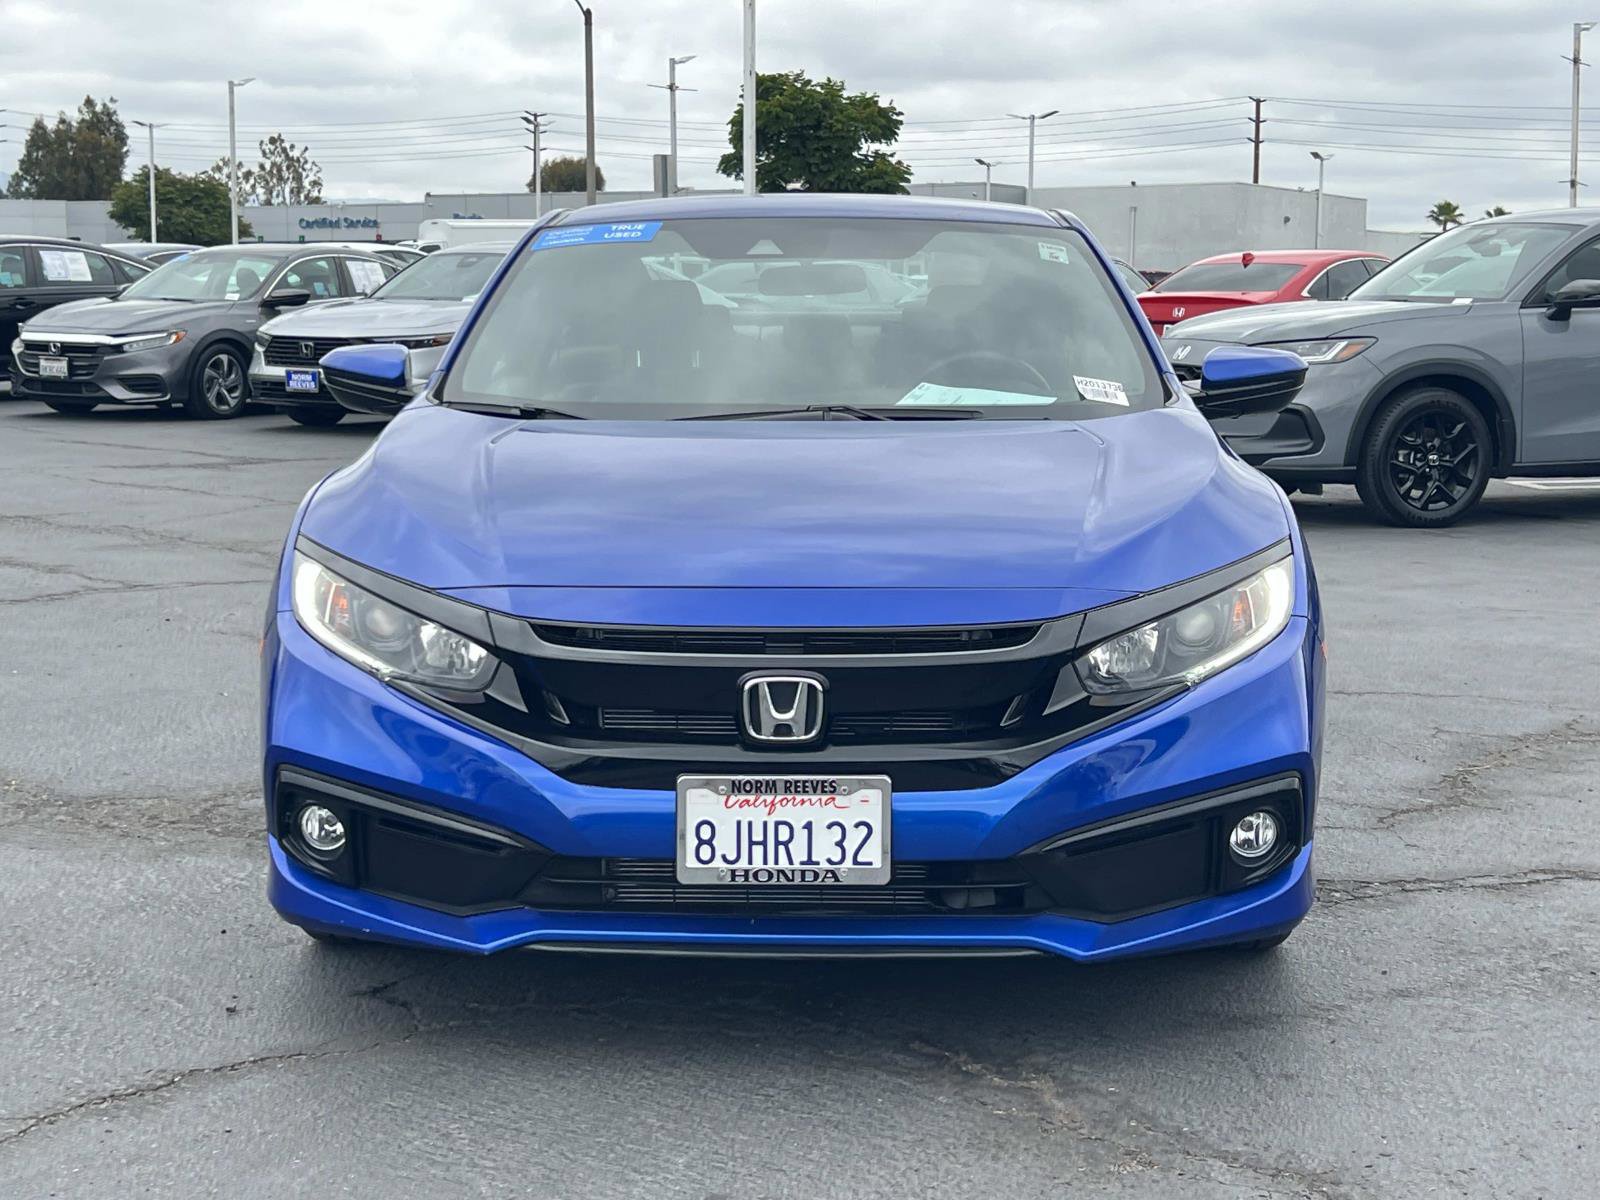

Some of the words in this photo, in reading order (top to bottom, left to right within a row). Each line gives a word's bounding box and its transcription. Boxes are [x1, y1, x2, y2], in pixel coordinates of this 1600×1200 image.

[298, 217, 341, 230] Certified
[343, 216, 380, 229] Service
[611, 223, 646, 231] TRUE
[604, 231, 643, 239] USED
[291, 373, 313, 381] NORM
[289, 380, 316, 389] REEVES
[731, 780, 778, 794] NORM
[784, 780, 837, 794] REEVES
[724, 794, 850, 816] California
[694, 819, 874, 866] 8JHR132
[728, 869, 844, 883] HONDA
